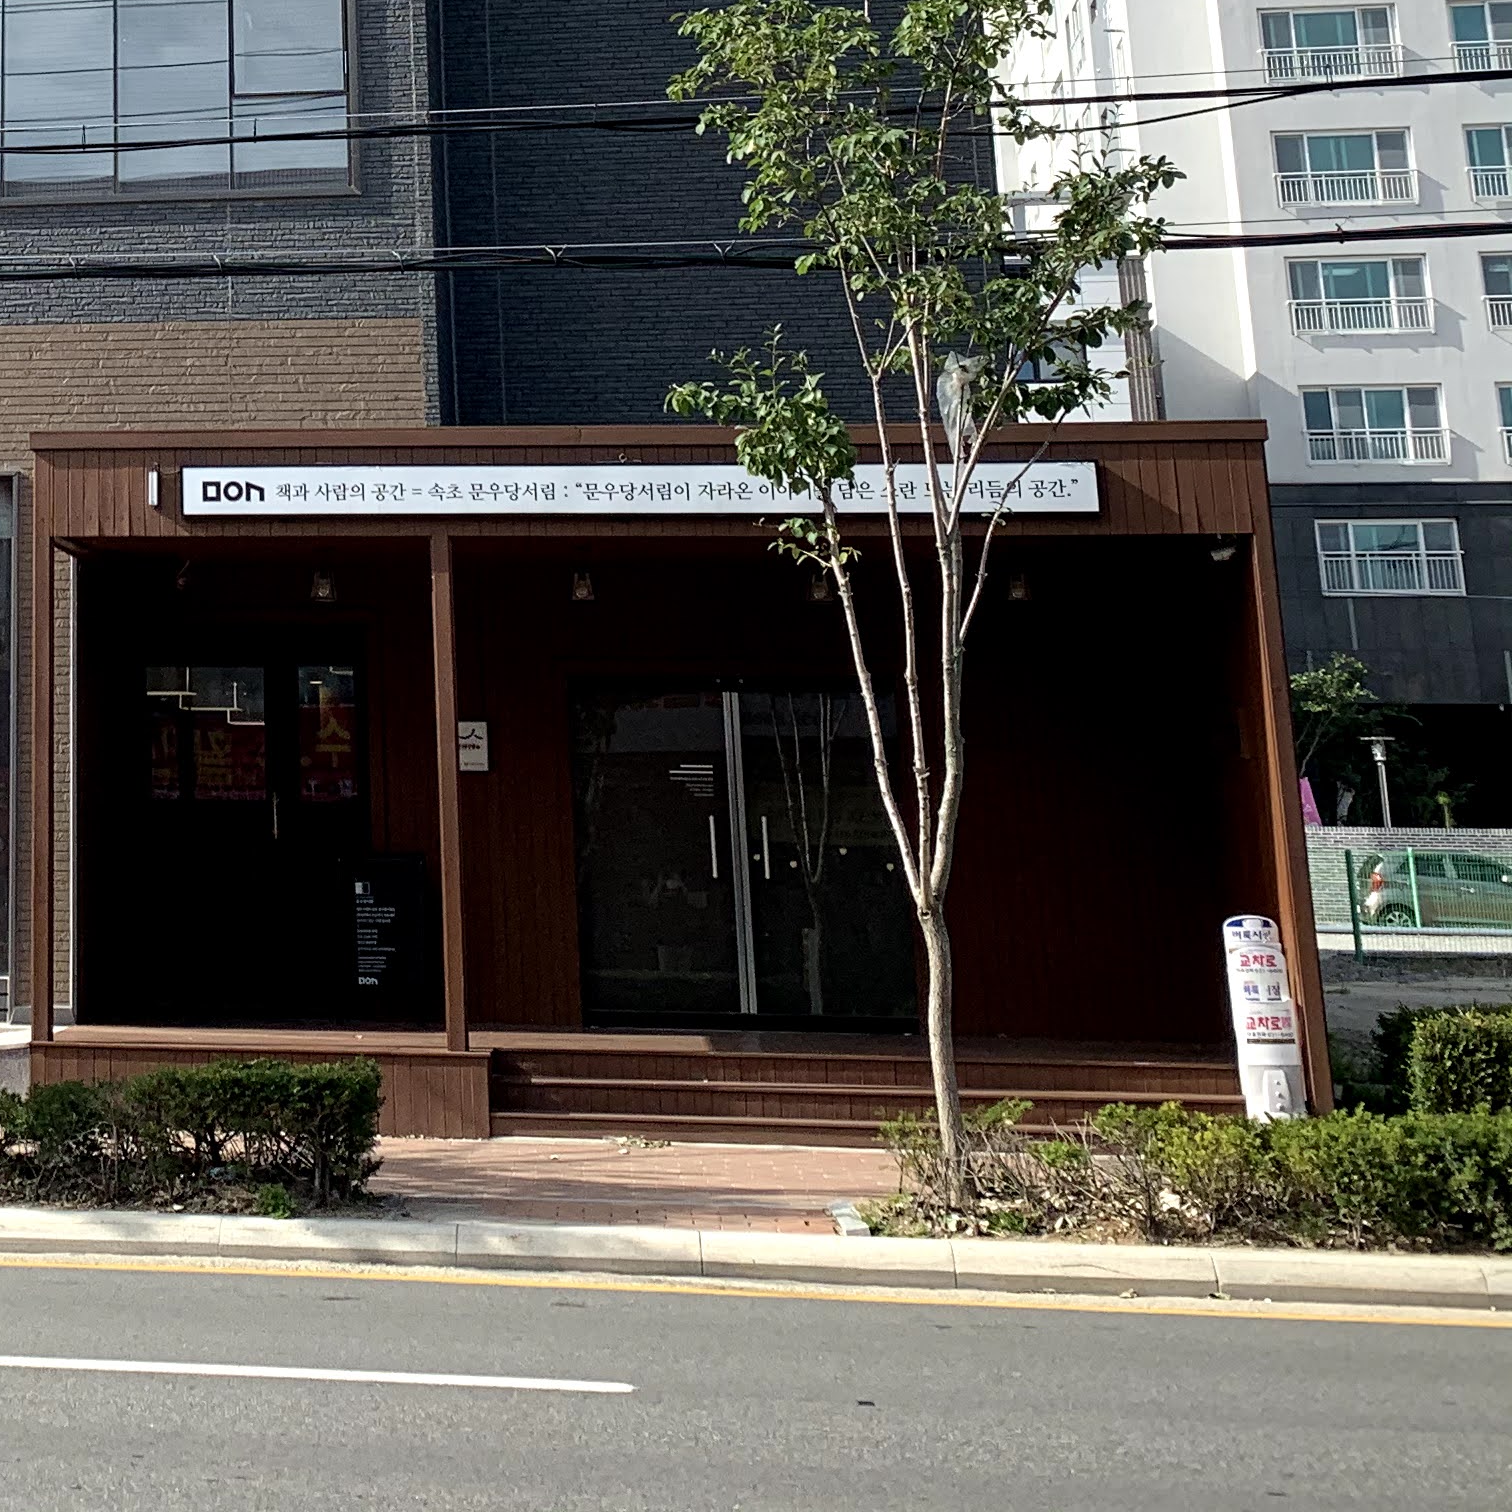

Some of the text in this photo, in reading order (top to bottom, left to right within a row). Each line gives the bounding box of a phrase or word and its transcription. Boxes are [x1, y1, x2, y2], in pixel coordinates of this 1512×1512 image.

[276, 482, 310, 502] 책과
[315, 482, 366, 502] 사람의
[371, 482, 407, 502] 공간
[427, 482, 464, 501] 속초
[468, 482, 556, 501] 문우당서림
[698, 481, 753, 501] 자라온
[1240, 954, 1277, 967] 교차로
